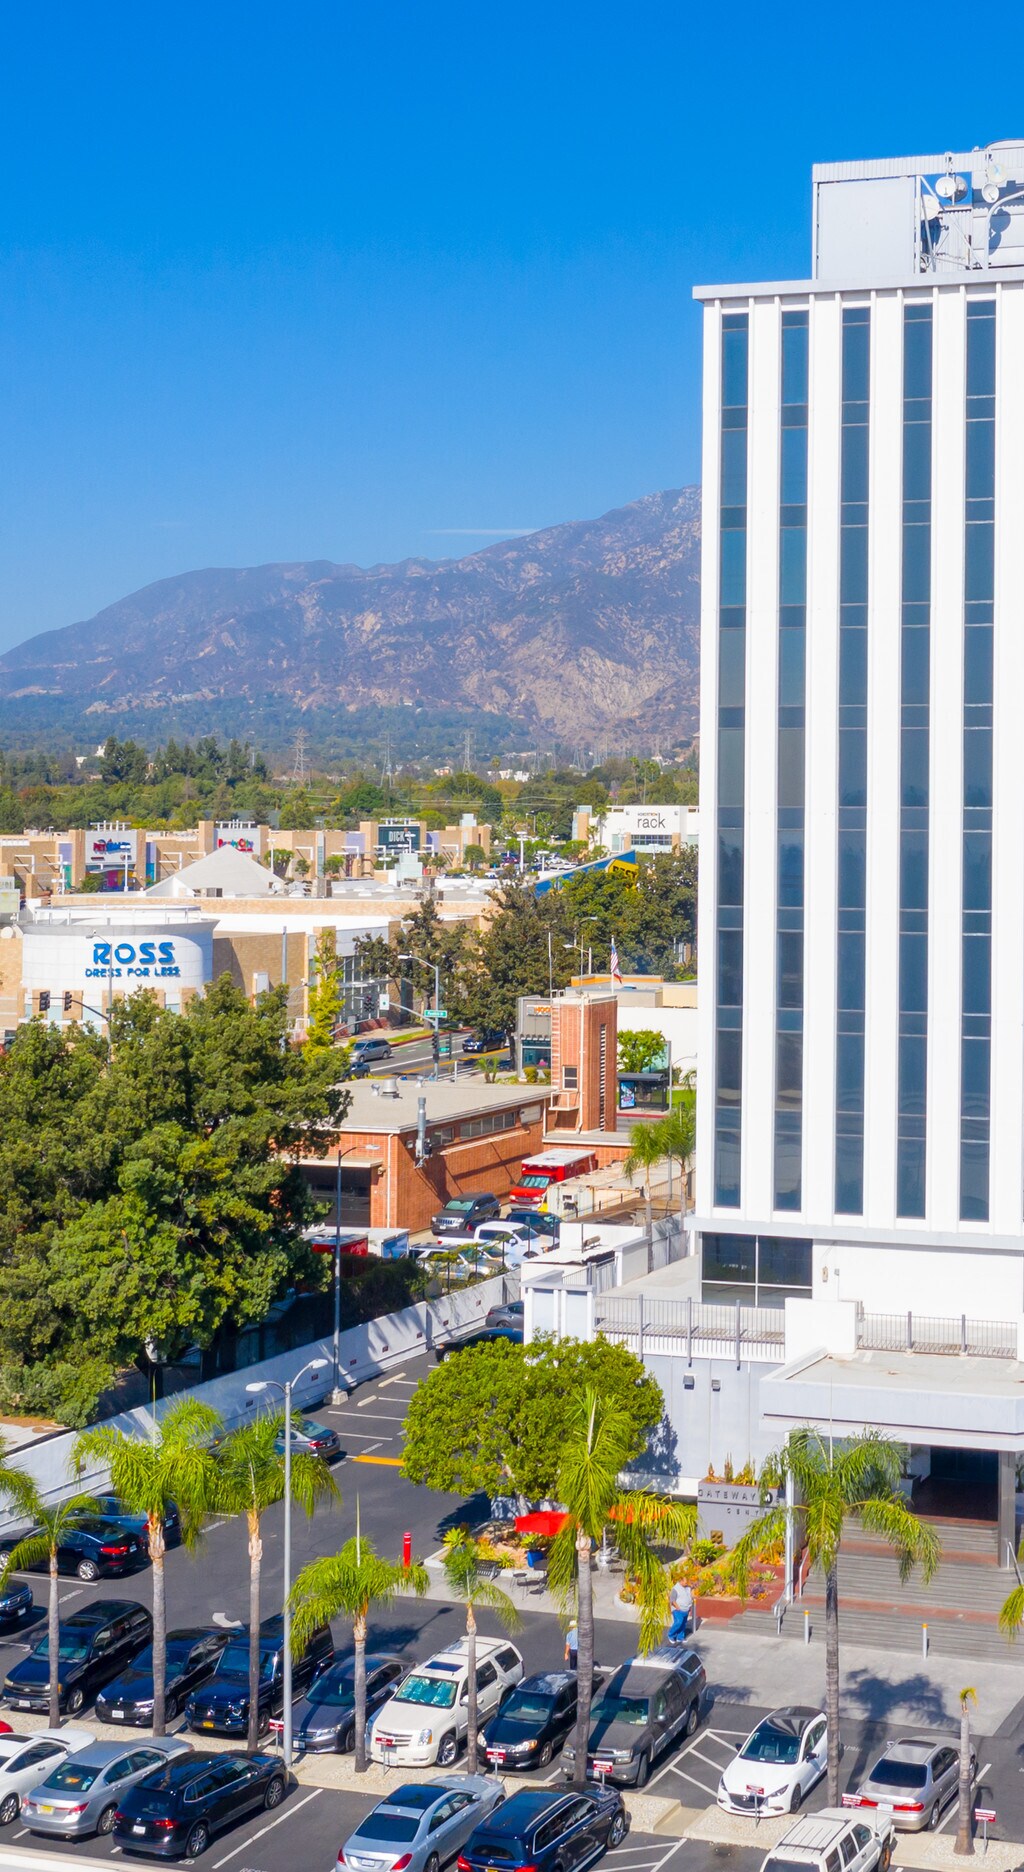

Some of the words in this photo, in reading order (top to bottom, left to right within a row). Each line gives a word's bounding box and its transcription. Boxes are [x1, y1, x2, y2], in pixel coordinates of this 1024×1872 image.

[637, 812, 666, 828] rack
[93, 942, 175, 965] ROSS
[85, 967, 122, 978] DRESS
[127, 967, 151, 977] FOR
[154, 966, 181, 978] LESS
[698, 1488, 757, 1502] GATEWAY
